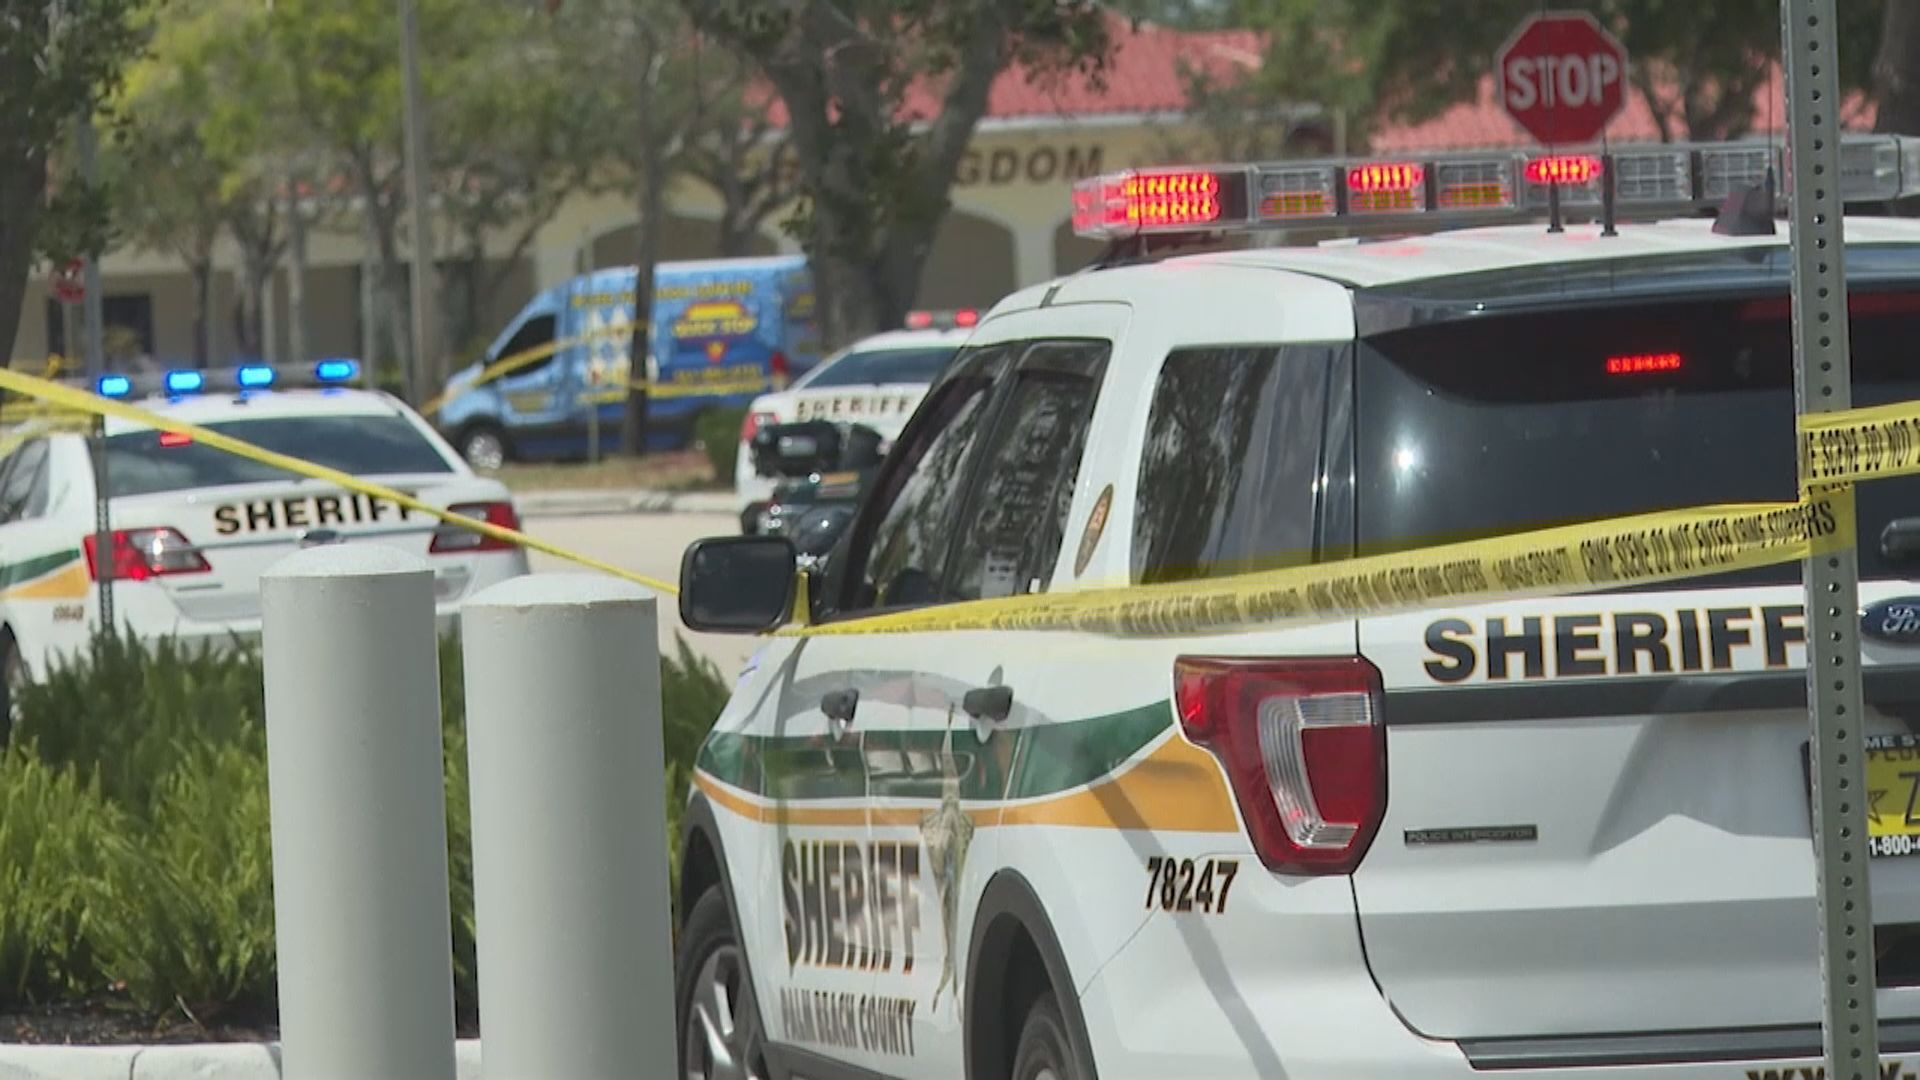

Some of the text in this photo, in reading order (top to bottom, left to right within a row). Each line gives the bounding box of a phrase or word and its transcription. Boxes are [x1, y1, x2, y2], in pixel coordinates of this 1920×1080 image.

[1506, 53, 1619, 111] STOP
[1820, 427, 1859, 478] SCENE
[1861, 423, 1884, 472] DO
[1883, 419, 1911, 468] NOT
[213, 490, 417, 534] SHERIFF
[1580, 535, 1620, 583] CRIME
[1614, 529, 1654, 580] SCENE
[1651, 526, 1671, 574] DO
[1669, 523, 1695, 571] NOT
[1694, 517, 1735, 568] ENTER
[1766, 500, 1836, 546] STOPPERS
[1422, 605, 1805, 684] SHERIFF
[782, 838, 921, 976] SHERIFF
[1146, 856, 1239, 914] 78247
[781, 986, 917, 1058] PALM BEACH COUNTY
